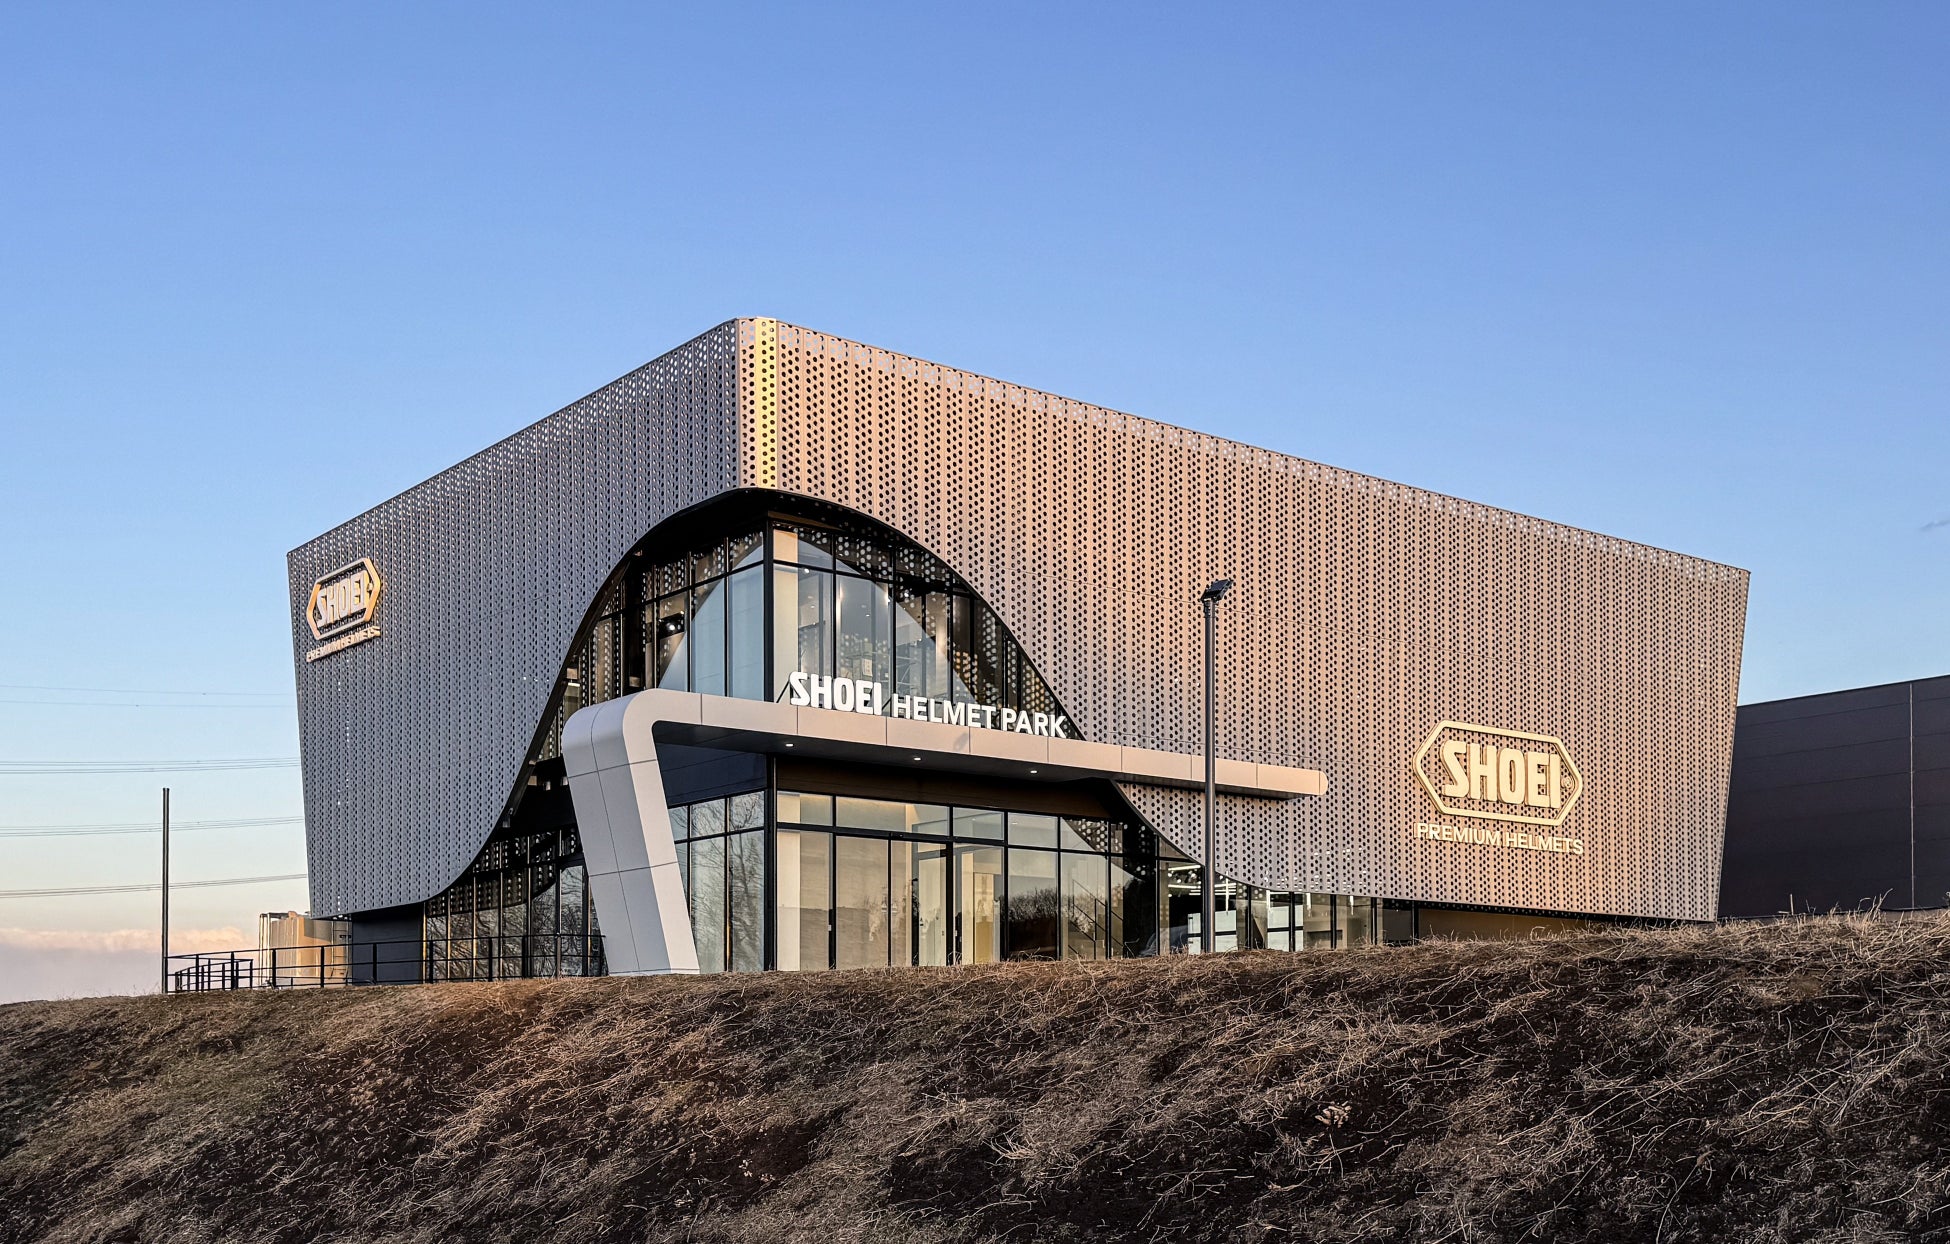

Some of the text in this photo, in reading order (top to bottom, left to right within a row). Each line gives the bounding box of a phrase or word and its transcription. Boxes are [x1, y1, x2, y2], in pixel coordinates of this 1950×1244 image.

[316, 570, 369, 628] SHOEI
[789, 671, 1067, 738] SHOEI HELMET PARK
[1440, 739, 1561, 809] SHOEI
[1415, 822, 1584, 855] PREMIUM HELMETS
